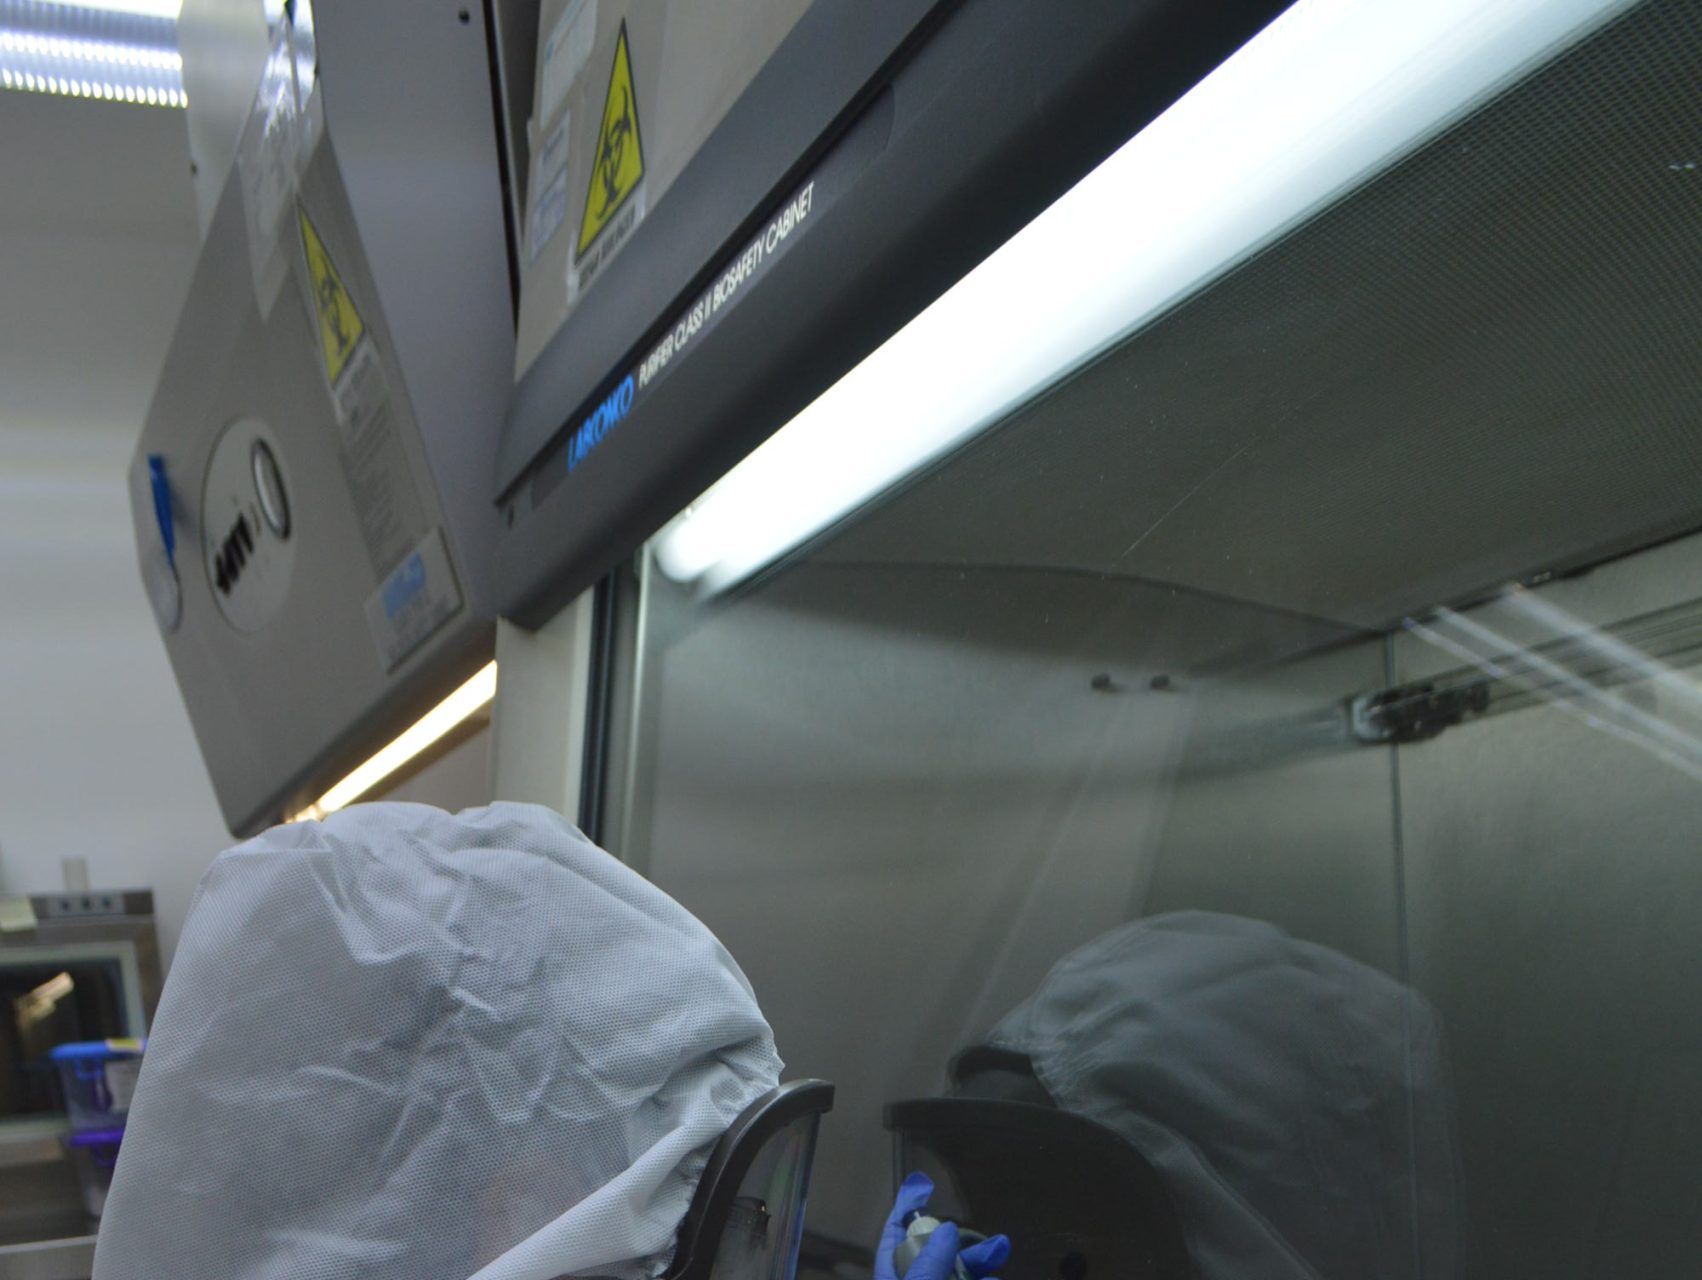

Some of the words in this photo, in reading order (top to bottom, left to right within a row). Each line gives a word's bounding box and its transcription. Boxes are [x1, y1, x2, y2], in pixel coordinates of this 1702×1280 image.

[675, 301, 704, 353] CLASS
[712, 234, 766, 312] BIOSAFETY
[766, 180, 815, 255] CABINET
